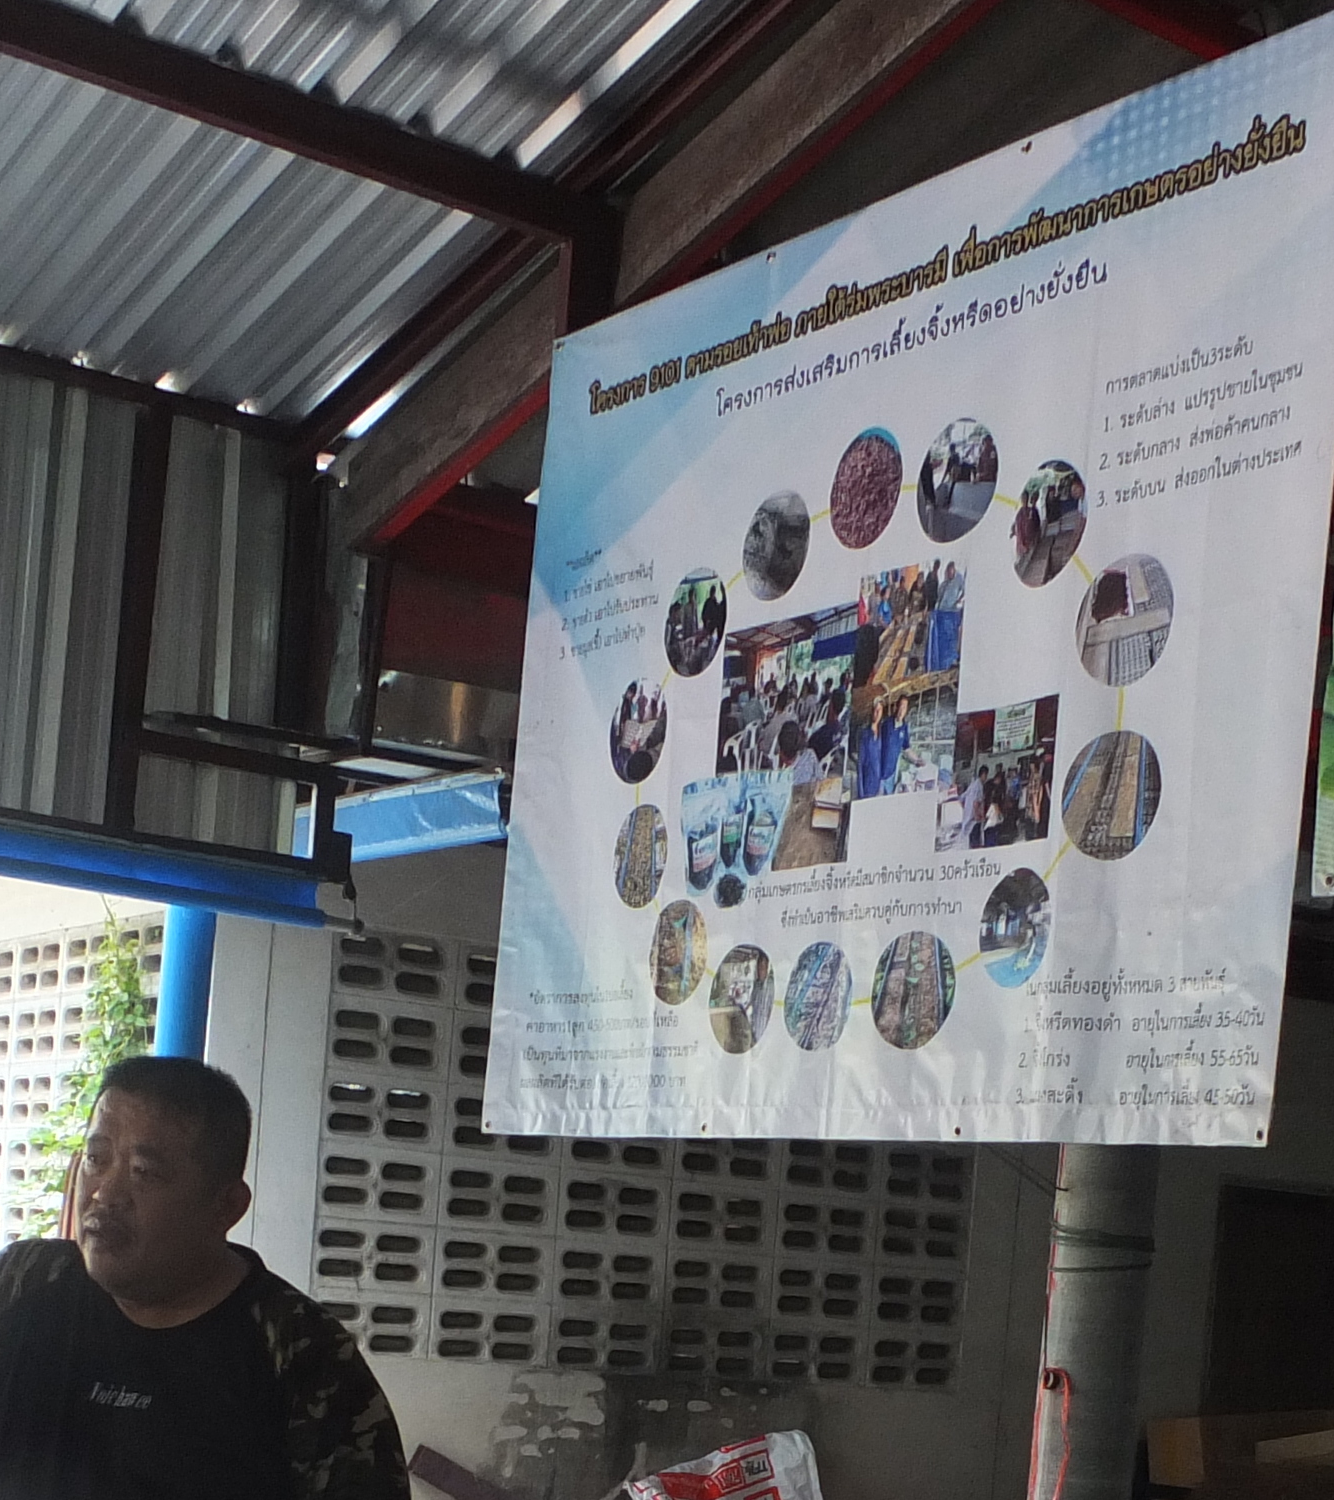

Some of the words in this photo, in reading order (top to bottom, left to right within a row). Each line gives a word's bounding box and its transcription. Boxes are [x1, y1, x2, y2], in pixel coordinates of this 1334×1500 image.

[715, 257, 1108, 418] โครงการส่งเสริมการเลี้ยงจิ้งหรีดอย่างยั่งยืน
